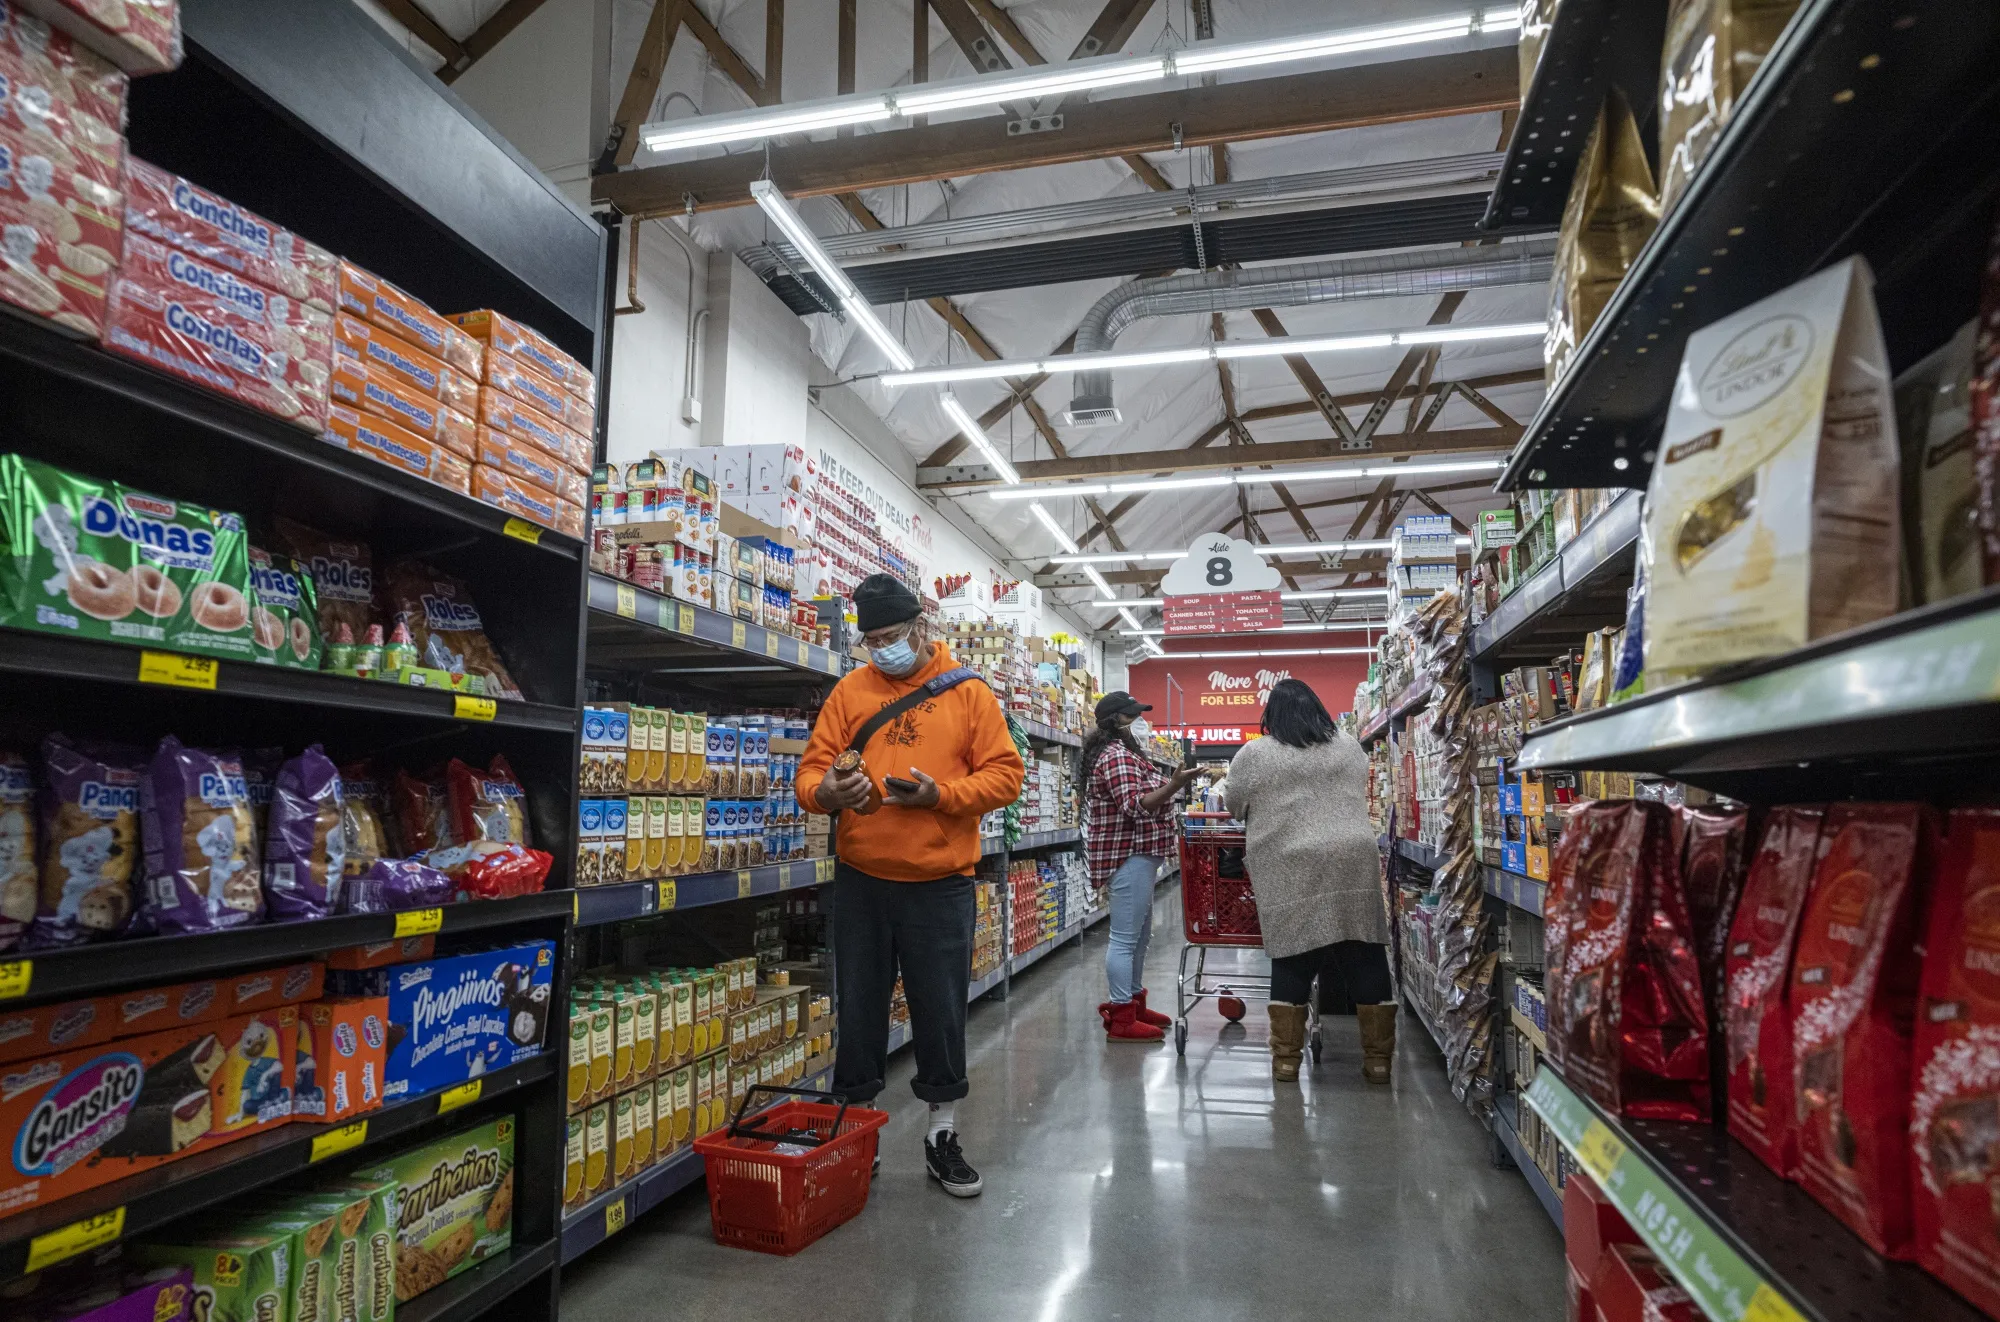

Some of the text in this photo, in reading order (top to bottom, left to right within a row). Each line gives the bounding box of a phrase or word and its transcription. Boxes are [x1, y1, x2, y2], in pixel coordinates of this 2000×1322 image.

[174, 184, 269, 244] Conchas
[168, 253, 265, 311] Conchas
[167, 303, 262, 365] Conchas
[367, 341, 390, 361] Mini
[365, 382, 388, 403] Mini
[357, 427, 427, 469] Mini Mantecadas
[819, 448, 837, 479] WE
[839, 464, 864, 497] KEEP
[865, 486, 884, 515] OUR
[885, 501, 910, 535] DEALS
[85, 501, 215, 557] Donas
[1208, 542, 1230, 553] Aisle
[247, 563, 298, 597] onas
[313, 558, 371, 590] Roles
[1206, 557, 1233, 587] 8
[424, 596, 477, 622] Roles
[1235, 607, 1268, 615] TOMATOES
[1208, 670, 1252, 692] More
[1200, 695, 1255, 706] FOR LESS
[1187, 729, 1198, 741] &
[1201, 728, 1241, 741] JUICE
[83, 784, 139, 811] Panq
[413, 969, 505, 1044] Pingüinos
[340, 1025, 353, 1055] Gansito
[368, 1016, 381, 1047] Gansito
[411, 1033, 444, 1068] Chocolate
[481, 1014, 505, 1036] Cupcakes
[24, 1066, 139, 1166] Gansito
[397, 1148, 498, 1238] Caribeñas
[430, 1210, 454, 1233] Cookies
[1634, 1190, 1694, 1261] NOSH
[336, 1241, 356, 1322] aribeñas
[371, 1233, 389, 1320] Caribeñas
